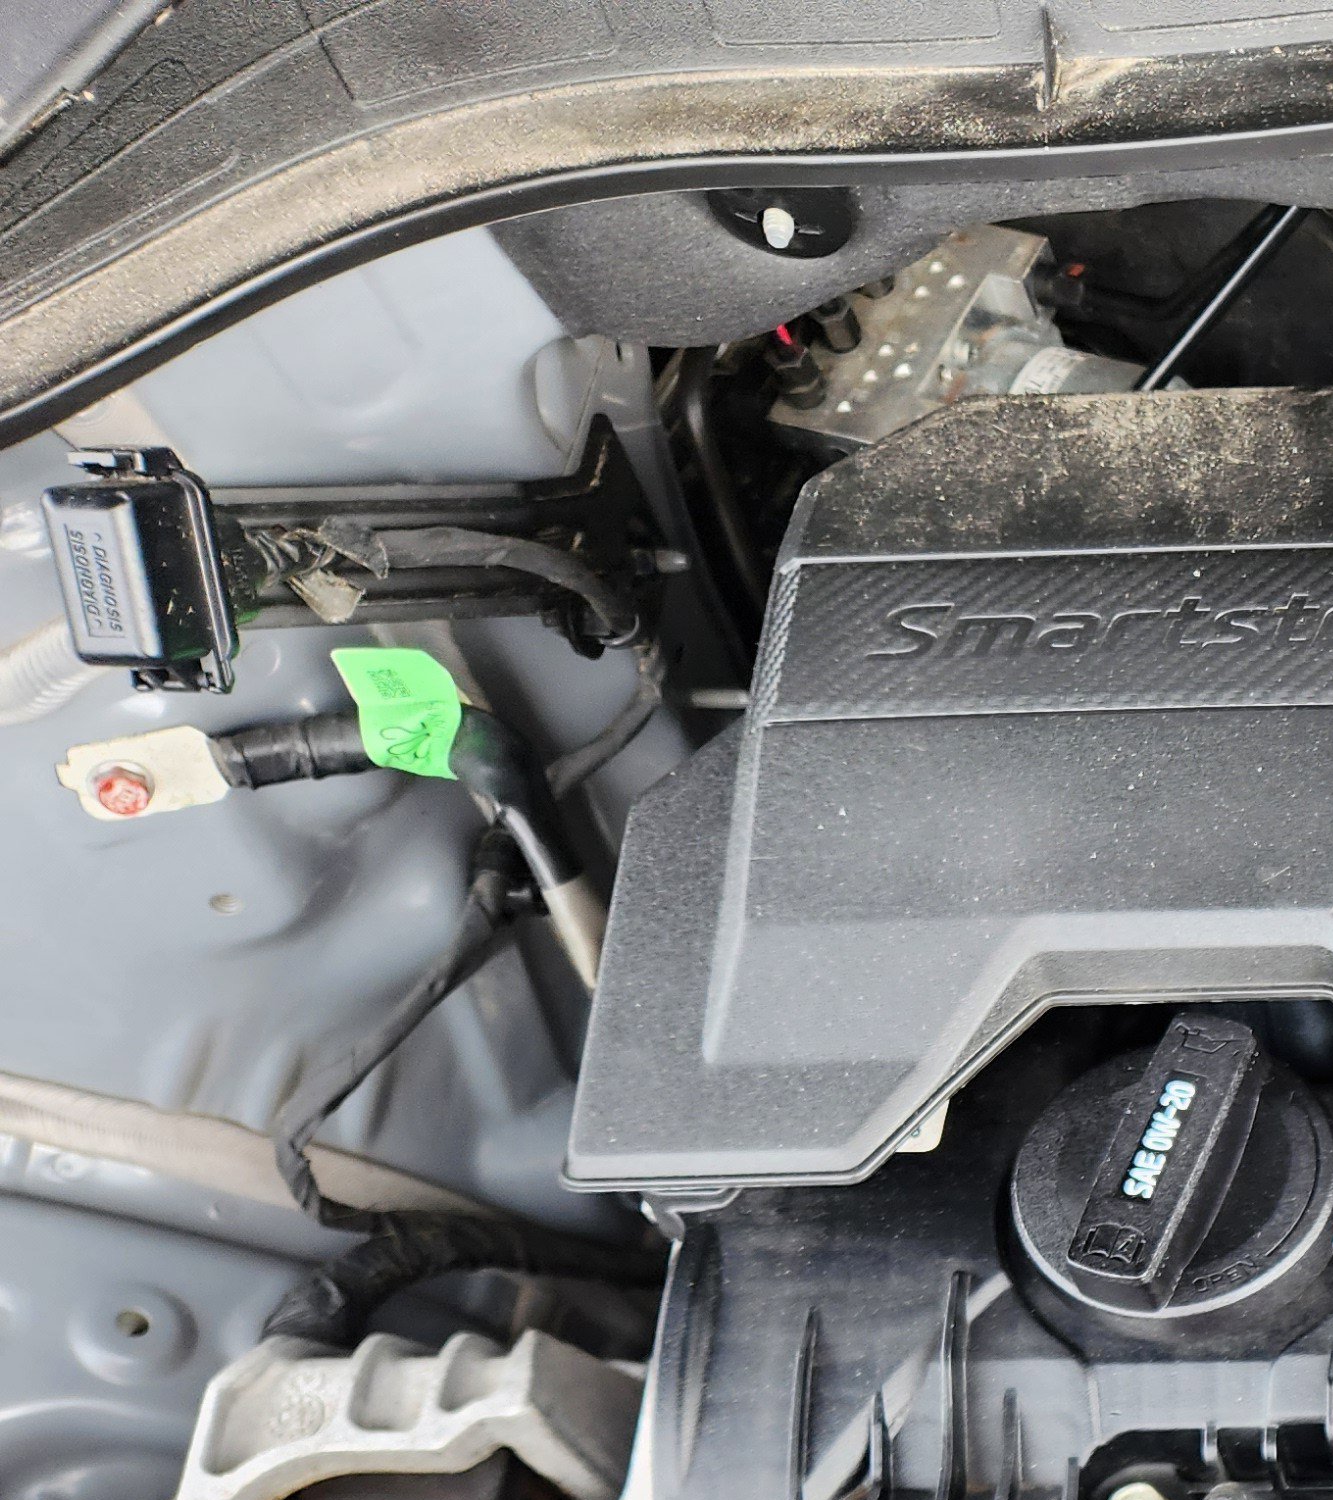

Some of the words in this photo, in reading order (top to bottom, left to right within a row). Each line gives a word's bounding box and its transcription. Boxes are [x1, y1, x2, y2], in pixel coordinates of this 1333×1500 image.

[69, 530, 101, 617] DIAGNOSIS
[92, 545, 123, 632] DIAGNOSIS
[1142, 1079, 1196, 1151] 0W-20
[1123, 1150, 1167, 1199] SAE
